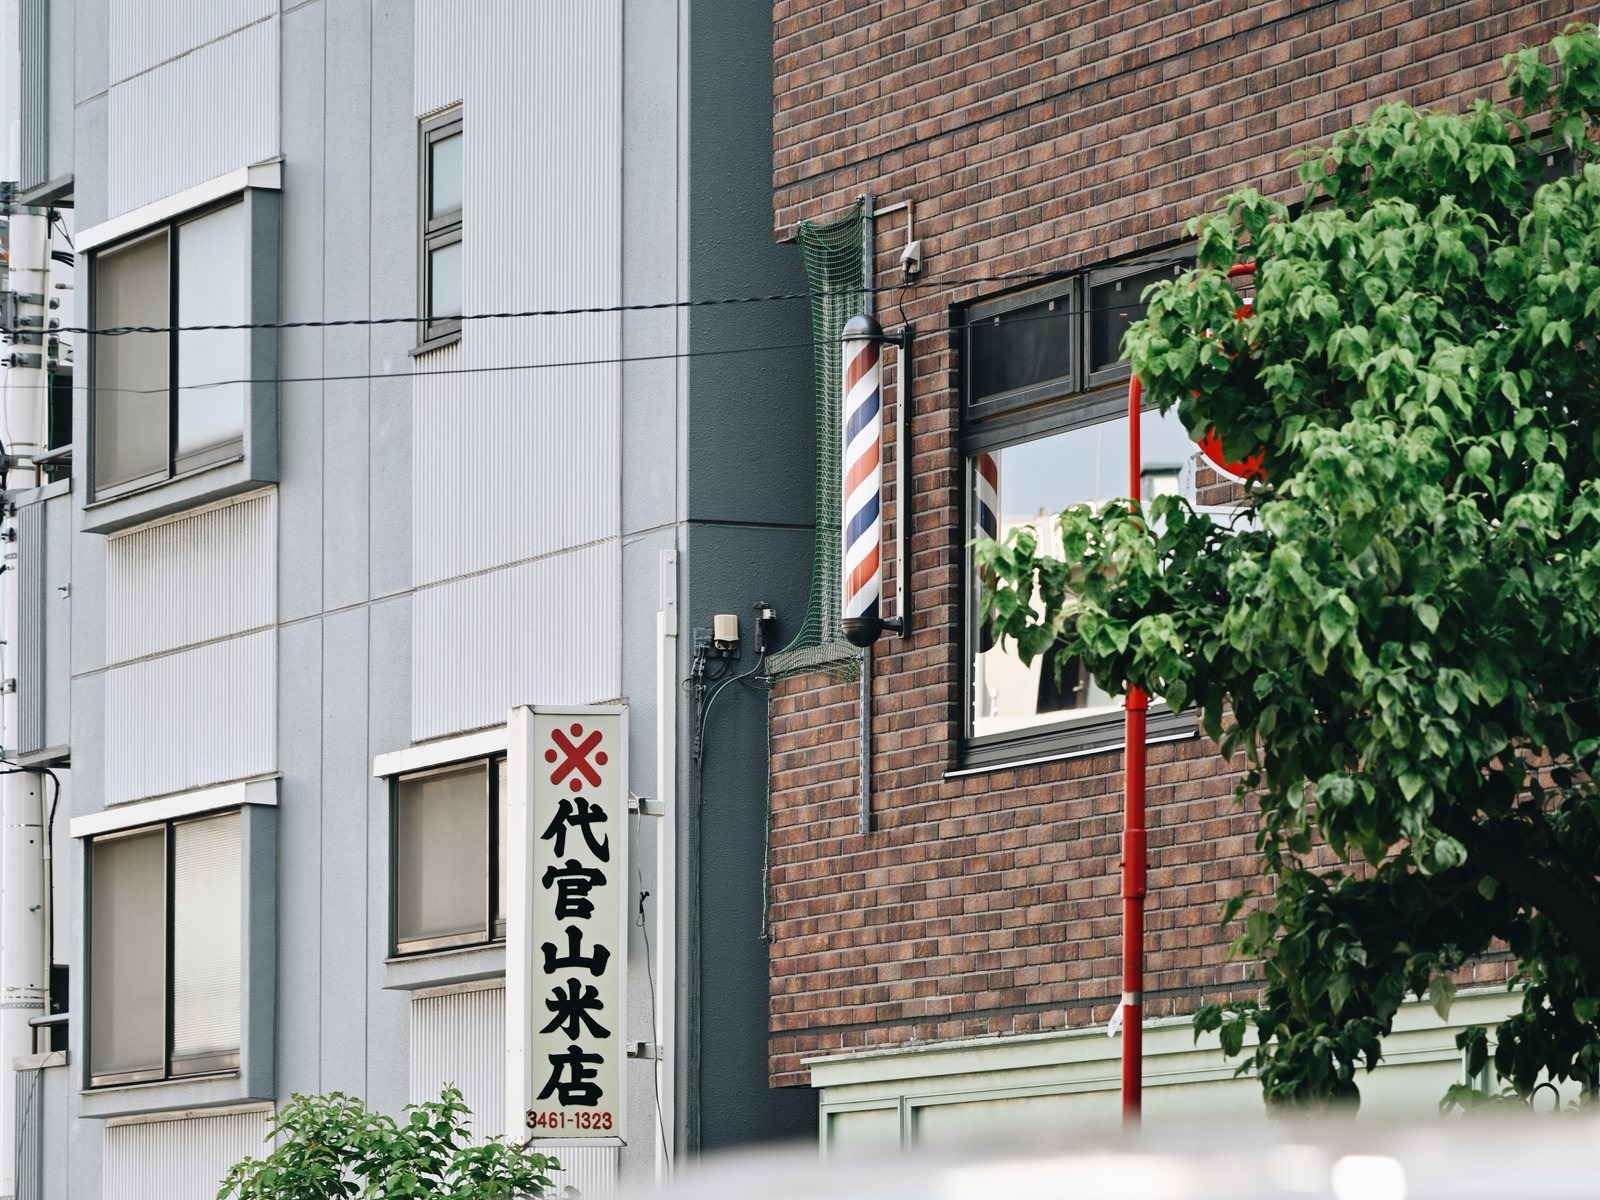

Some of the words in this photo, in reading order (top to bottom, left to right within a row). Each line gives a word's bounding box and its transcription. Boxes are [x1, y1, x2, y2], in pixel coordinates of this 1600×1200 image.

[536, 796, 612, 1107] 代官山米店
[526, 1110, 613, 1130] 3461-1323
